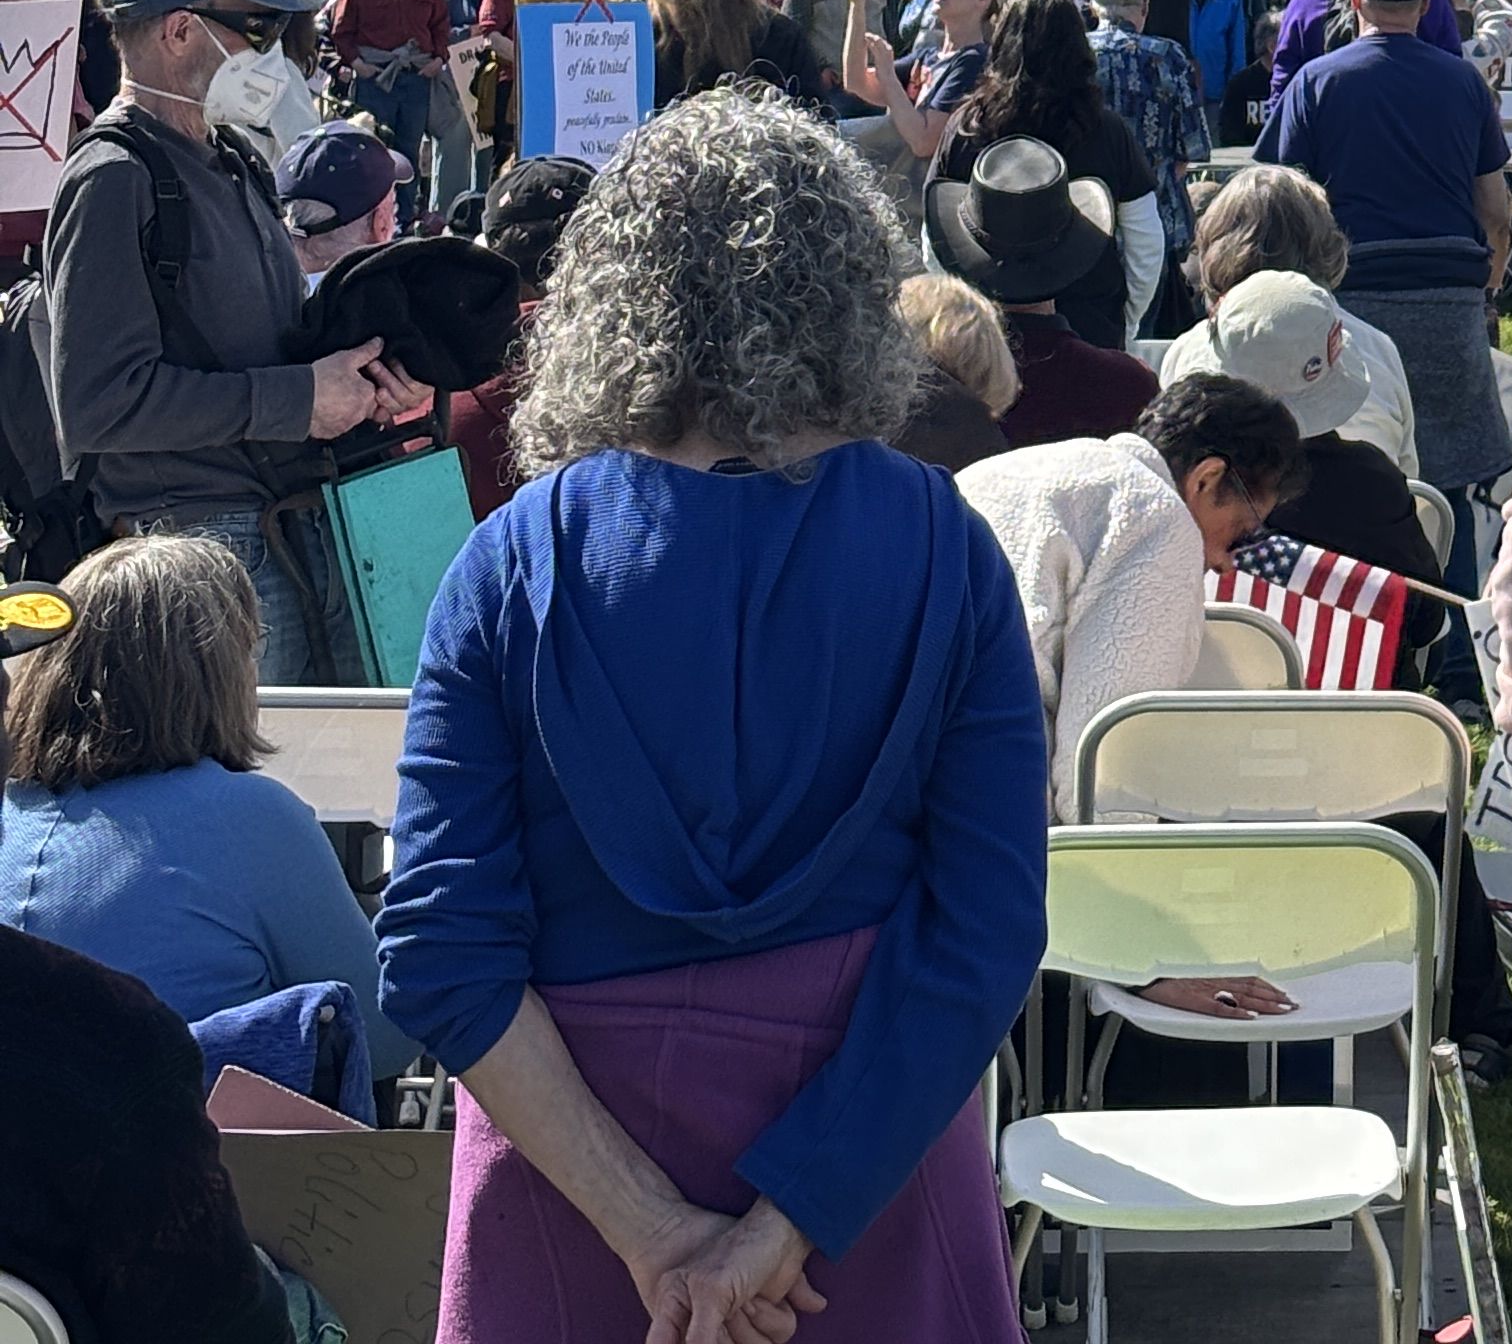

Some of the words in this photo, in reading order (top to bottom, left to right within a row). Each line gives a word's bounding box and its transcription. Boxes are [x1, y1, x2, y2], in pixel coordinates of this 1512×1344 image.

[565, 28, 582, 47] We
[583, 28, 600, 47] the
[601, 28, 630, 52] People
[567, 58, 582, 81] of
[581, 57, 597, 76] the
[599, 56, 632, 76] United
[580, 140, 596, 155] NO
